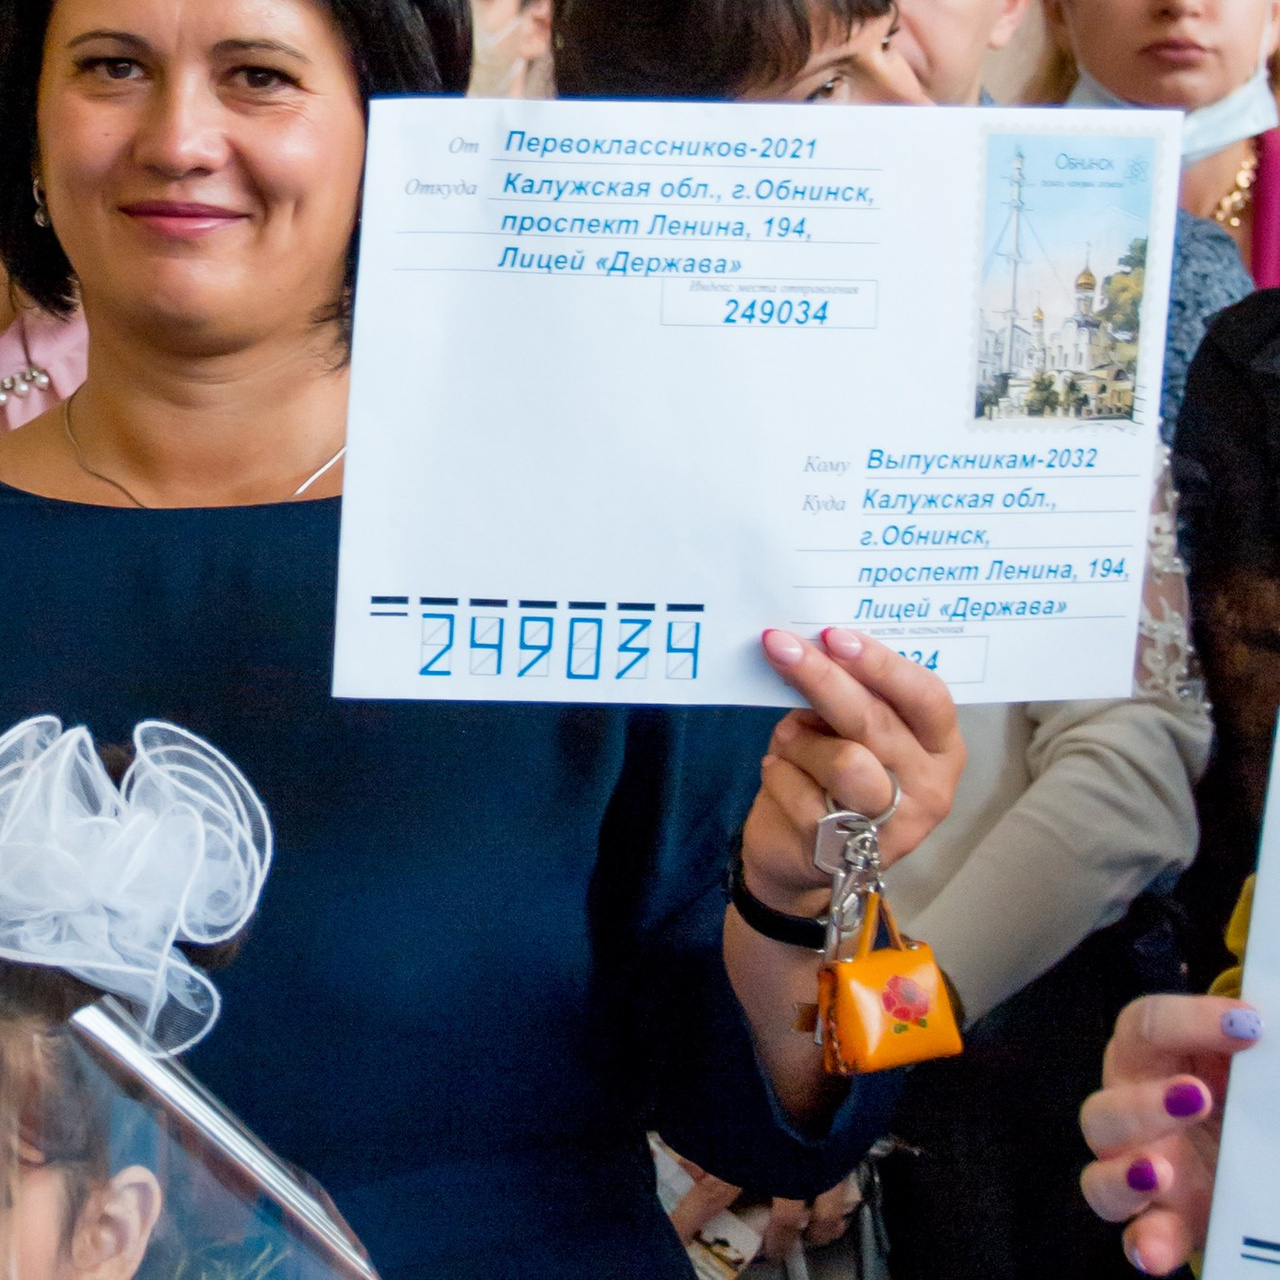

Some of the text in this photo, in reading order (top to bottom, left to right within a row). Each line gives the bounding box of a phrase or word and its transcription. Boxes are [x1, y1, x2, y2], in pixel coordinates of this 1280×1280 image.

[504, 130, 818, 159] Первоклассников-2021
[502, 172, 651, 202] Калужская
[660, 177, 722, 201] обл.,
[731, 178, 874, 206] г.Обнинск,
[500, 214, 812, 241] проспект Ленина, 194,
[497, 247, 742, 278] Лицей «Держава»
[723, 298, 829, 325] 249034
[866, 447, 1099, 476] Выпускникам-2032
[862, 488, 995, 516] Калужская
[1001, 487, 1057, 510] обл.,
[860, 524, 991, 548] г.Обнинск,
[858, 557, 1130, 588] проспект Ленина, 194,
[854, 596, 1067, 623] Лицей «Держава»
[418, 612, 701, 681] 249034
